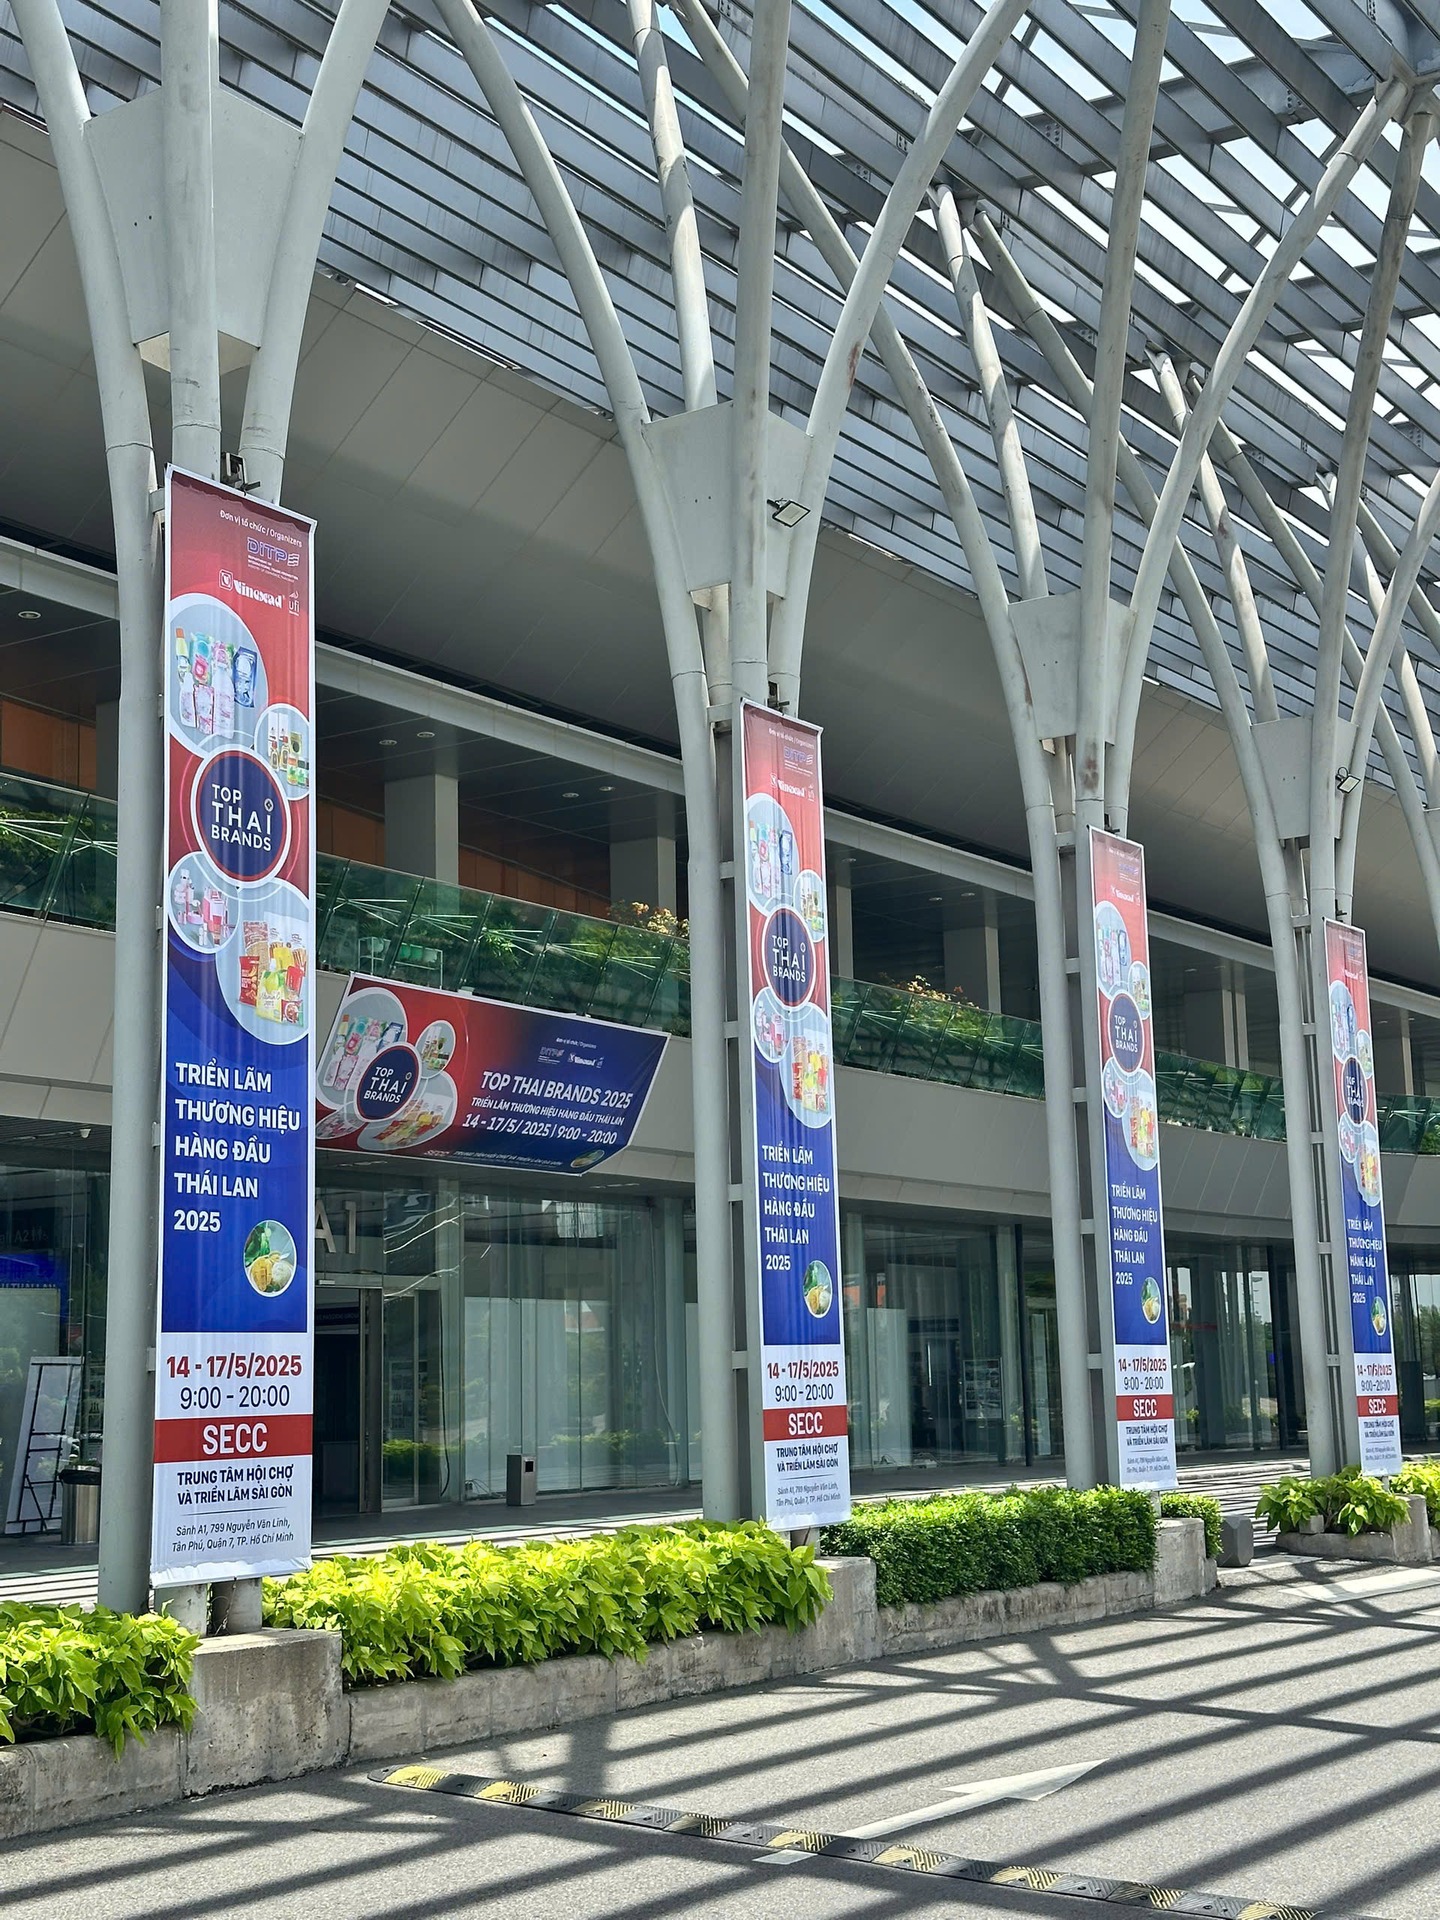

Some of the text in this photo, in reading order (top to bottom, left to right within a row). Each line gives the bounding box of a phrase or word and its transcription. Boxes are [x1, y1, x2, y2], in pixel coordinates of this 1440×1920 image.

[220, 510, 233, 522] Đơn
[270, 529, 302, 547] Organizers
[247, 537, 287, 562] DITP
[289, 601, 299, 612] ufi
[212, 784, 242, 803] TOP
[212, 801, 271, 835] THAI
[211, 825, 271, 851] BRANDS
[772, 935, 788, 949] TOP
[772, 948, 805, 970] THAI
[773, 965, 805, 982] BRANDS
[1115, 1015, 1126, 1026] TOP
[1115, 1025, 1138, 1042] THAI
[1116, 1039, 1138, 1052] BRANDS
[176, 1058, 271, 1092] TRIỂN LÃM
[375, 1067, 394, 1077] TOP
[371, 1077, 407, 1093] THAI
[481, 1071, 633, 1109] TOP THAI BRANDS 2025
[364, 1090, 401, 1103] BRANDS
[471, 1094, 494, 1109] TRIỂN
[511, 1102, 540, 1114] THƯƠNG
[542, 1105, 557, 1118] HIỆU
[175, 1099, 300, 1134] THƯƠNG HIỆU
[462, 1113, 479, 1128] 14
[487, 1116, 522, 1134] 17/5/
[522, 1120, 550, 1137] 2025
[557, 1126, 581, 1140] 9:00
[587, 1129, 617, 1145] 20:00
[175, 1132, 271, 1163] HÀNG ĐẦU
[762, 1141, 813, 1165] TRIỂN LÃM
[174, 1170, 258, 1198] THÁI LAN
[763, 1172, 830, 1195] THƯƠNG HIỆU
[764, 1196, 814, 1218] HÀNG ĐẦU
[1112, 1206, 1157, 1225] THƯƠNG HIỆU
[174, 1209, 221, 1232] 2025
[315, 1199, 356, 1253] A1
[765, 1224, 809, 1244] THÁI LAN
[1114, 1226, 1132, 1241] HÀNG
[766, 1255, 791, 1270] 2025
[1131, 1251, 1145, 1264] LAN
[1116, 1272, 1133, 1285] 2025
[166, 1356, 190, 1378] 14
[206, 1353, 301, 1379] 17/5/2025
[768, 1362, 779, 1379] 14
[788, 1359, 839, 1380] 17/5/2025
[1118, 1359, 1127, 1372] 14
[1132, 1357, 1167, 1372] 17/5/2025
[775, 1386, 797, 1402] 9:00
[806, 1384, 833, 1400] 20:00
[1124, 1377, 1139, 1390] 9:00
[1145, 1377, 1164, 1390] 20:00
[180, 1386, 221, 1409] 9:00
[239, 1385, 290, 1407] 20:00
[1369, 1399, 1386, 1414] SECC
[1133, 1399, 1157, 1417] SECC
[789, 1412, 822, 1435] SECC
[202, 1422, 267, 1454] SECC
[776, 1442, 838, 1458] TRUNG TÂM HỘI CHỢ
[177, 1464, 294, 1485] TRUNG TÂM HỘI CHỢ
[777, 1461, 785, 1472] VÀ
[816, 1458, 825, 1468] SÀI
[826, 1457, 838, 1467] GÒN
[177, 1483, 292, 1505] VÀ TRIỂN LÃM SÀI GÒN
[198, 1525, 208, 1535] A1,
[211, 1523, 224, 1533] 799
[257, 1519, 270, 1529] Văn
[272, 1518, 290, 1529] Linh,
[172, 1541, 186, 1552] Tân
[188, 1540, 205, 1552] Phú,
[207, 1538, 226, 1550] Quận
[229, 1538, 235, 1549] 7,
[237, 1537, 248, 1546] TP.
[262, 1533, 274, 1543] Chí
[276, 1532, 294, 1542] Minh
